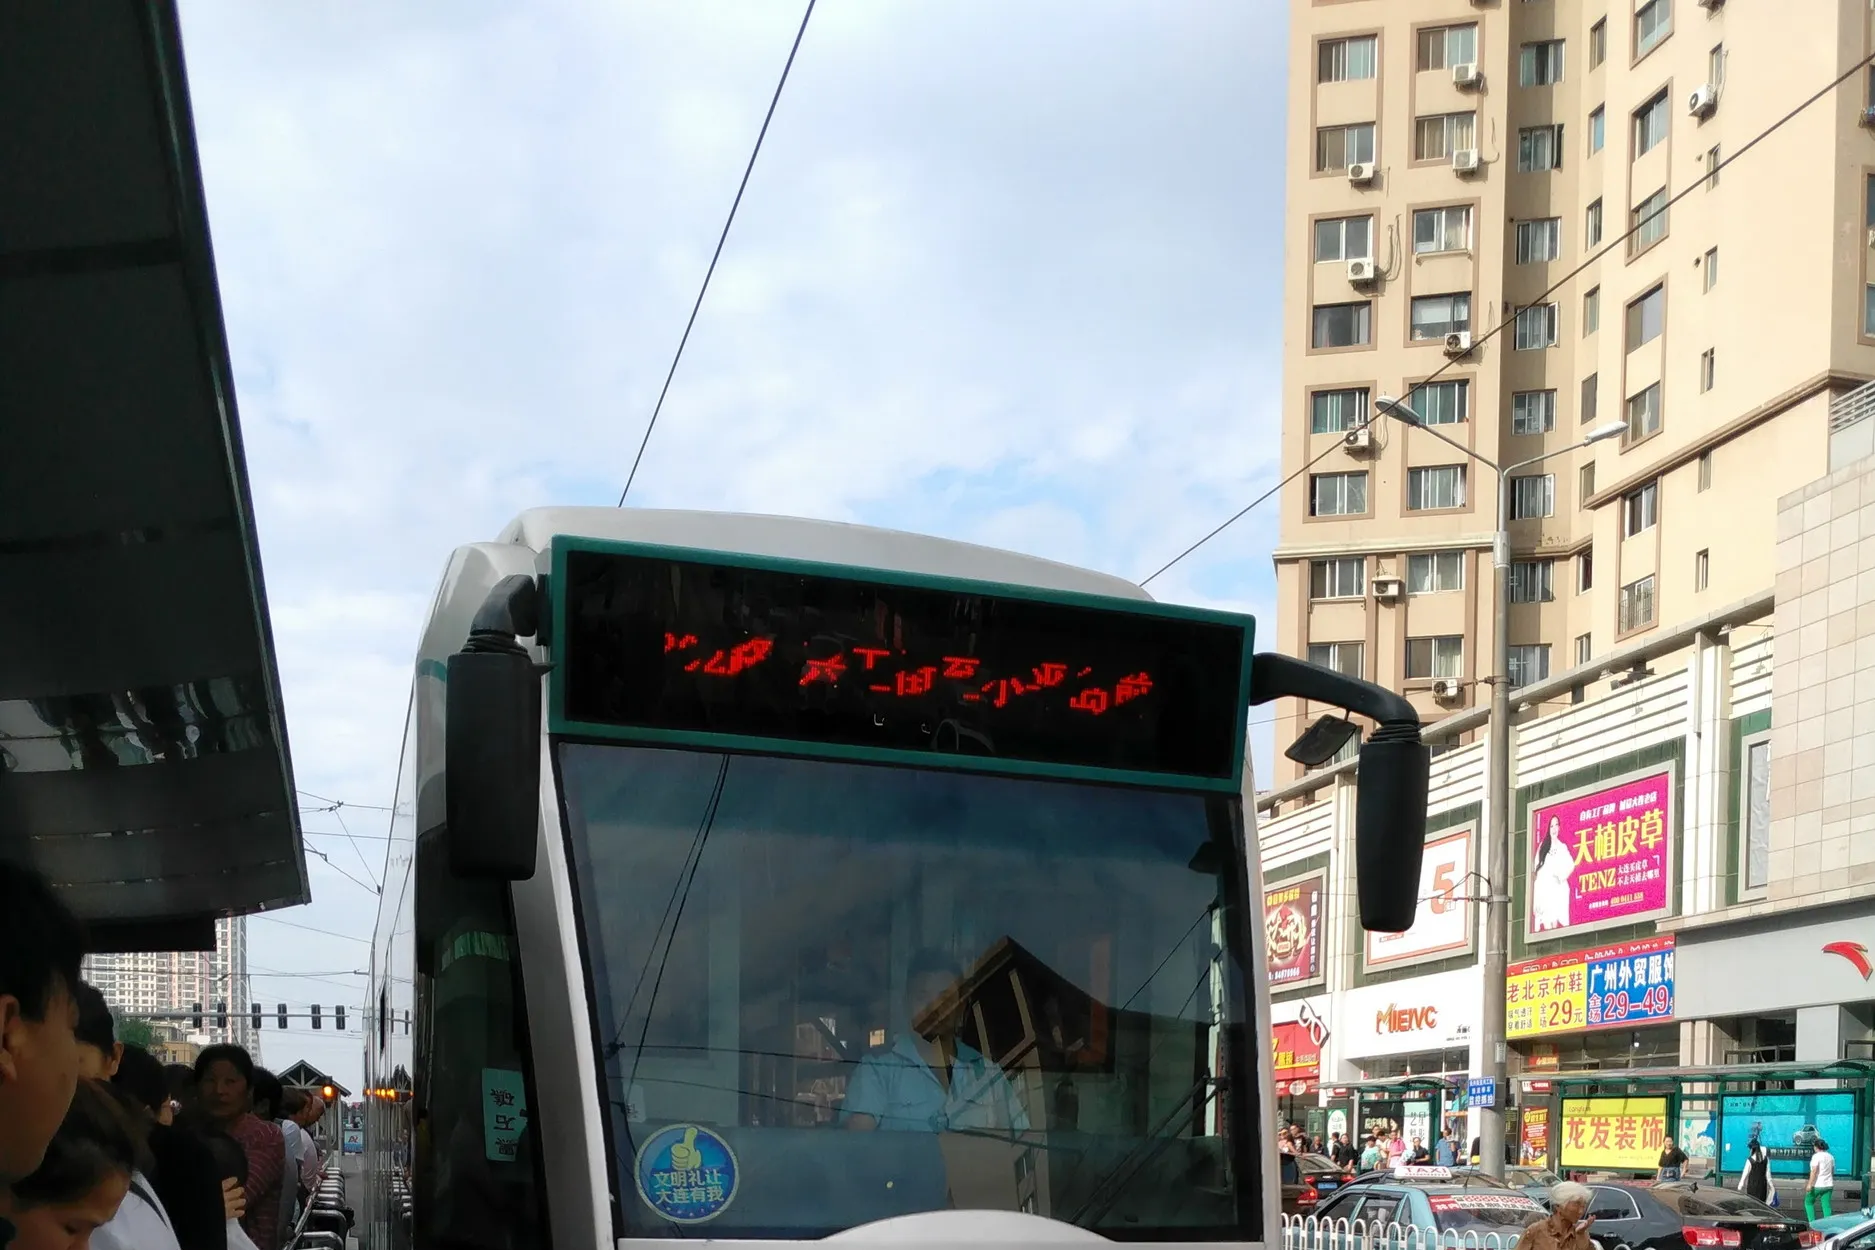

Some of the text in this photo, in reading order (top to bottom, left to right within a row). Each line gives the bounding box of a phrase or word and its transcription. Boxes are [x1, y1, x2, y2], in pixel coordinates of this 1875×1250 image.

[1573, 808, 1664, 866] 天植皮草
[1578, 868, 1616, 893] TENZ
[1507, 971, 1583, 1003] 老北京布鞋
[1588, 993, 1602, 1023] 全场
[1565, 1116, 1664, 1151] 龙发装饰
[653, 1169, 722, 1188] 文明礼让
[656, 1186, 724, 1204] 大连有我
